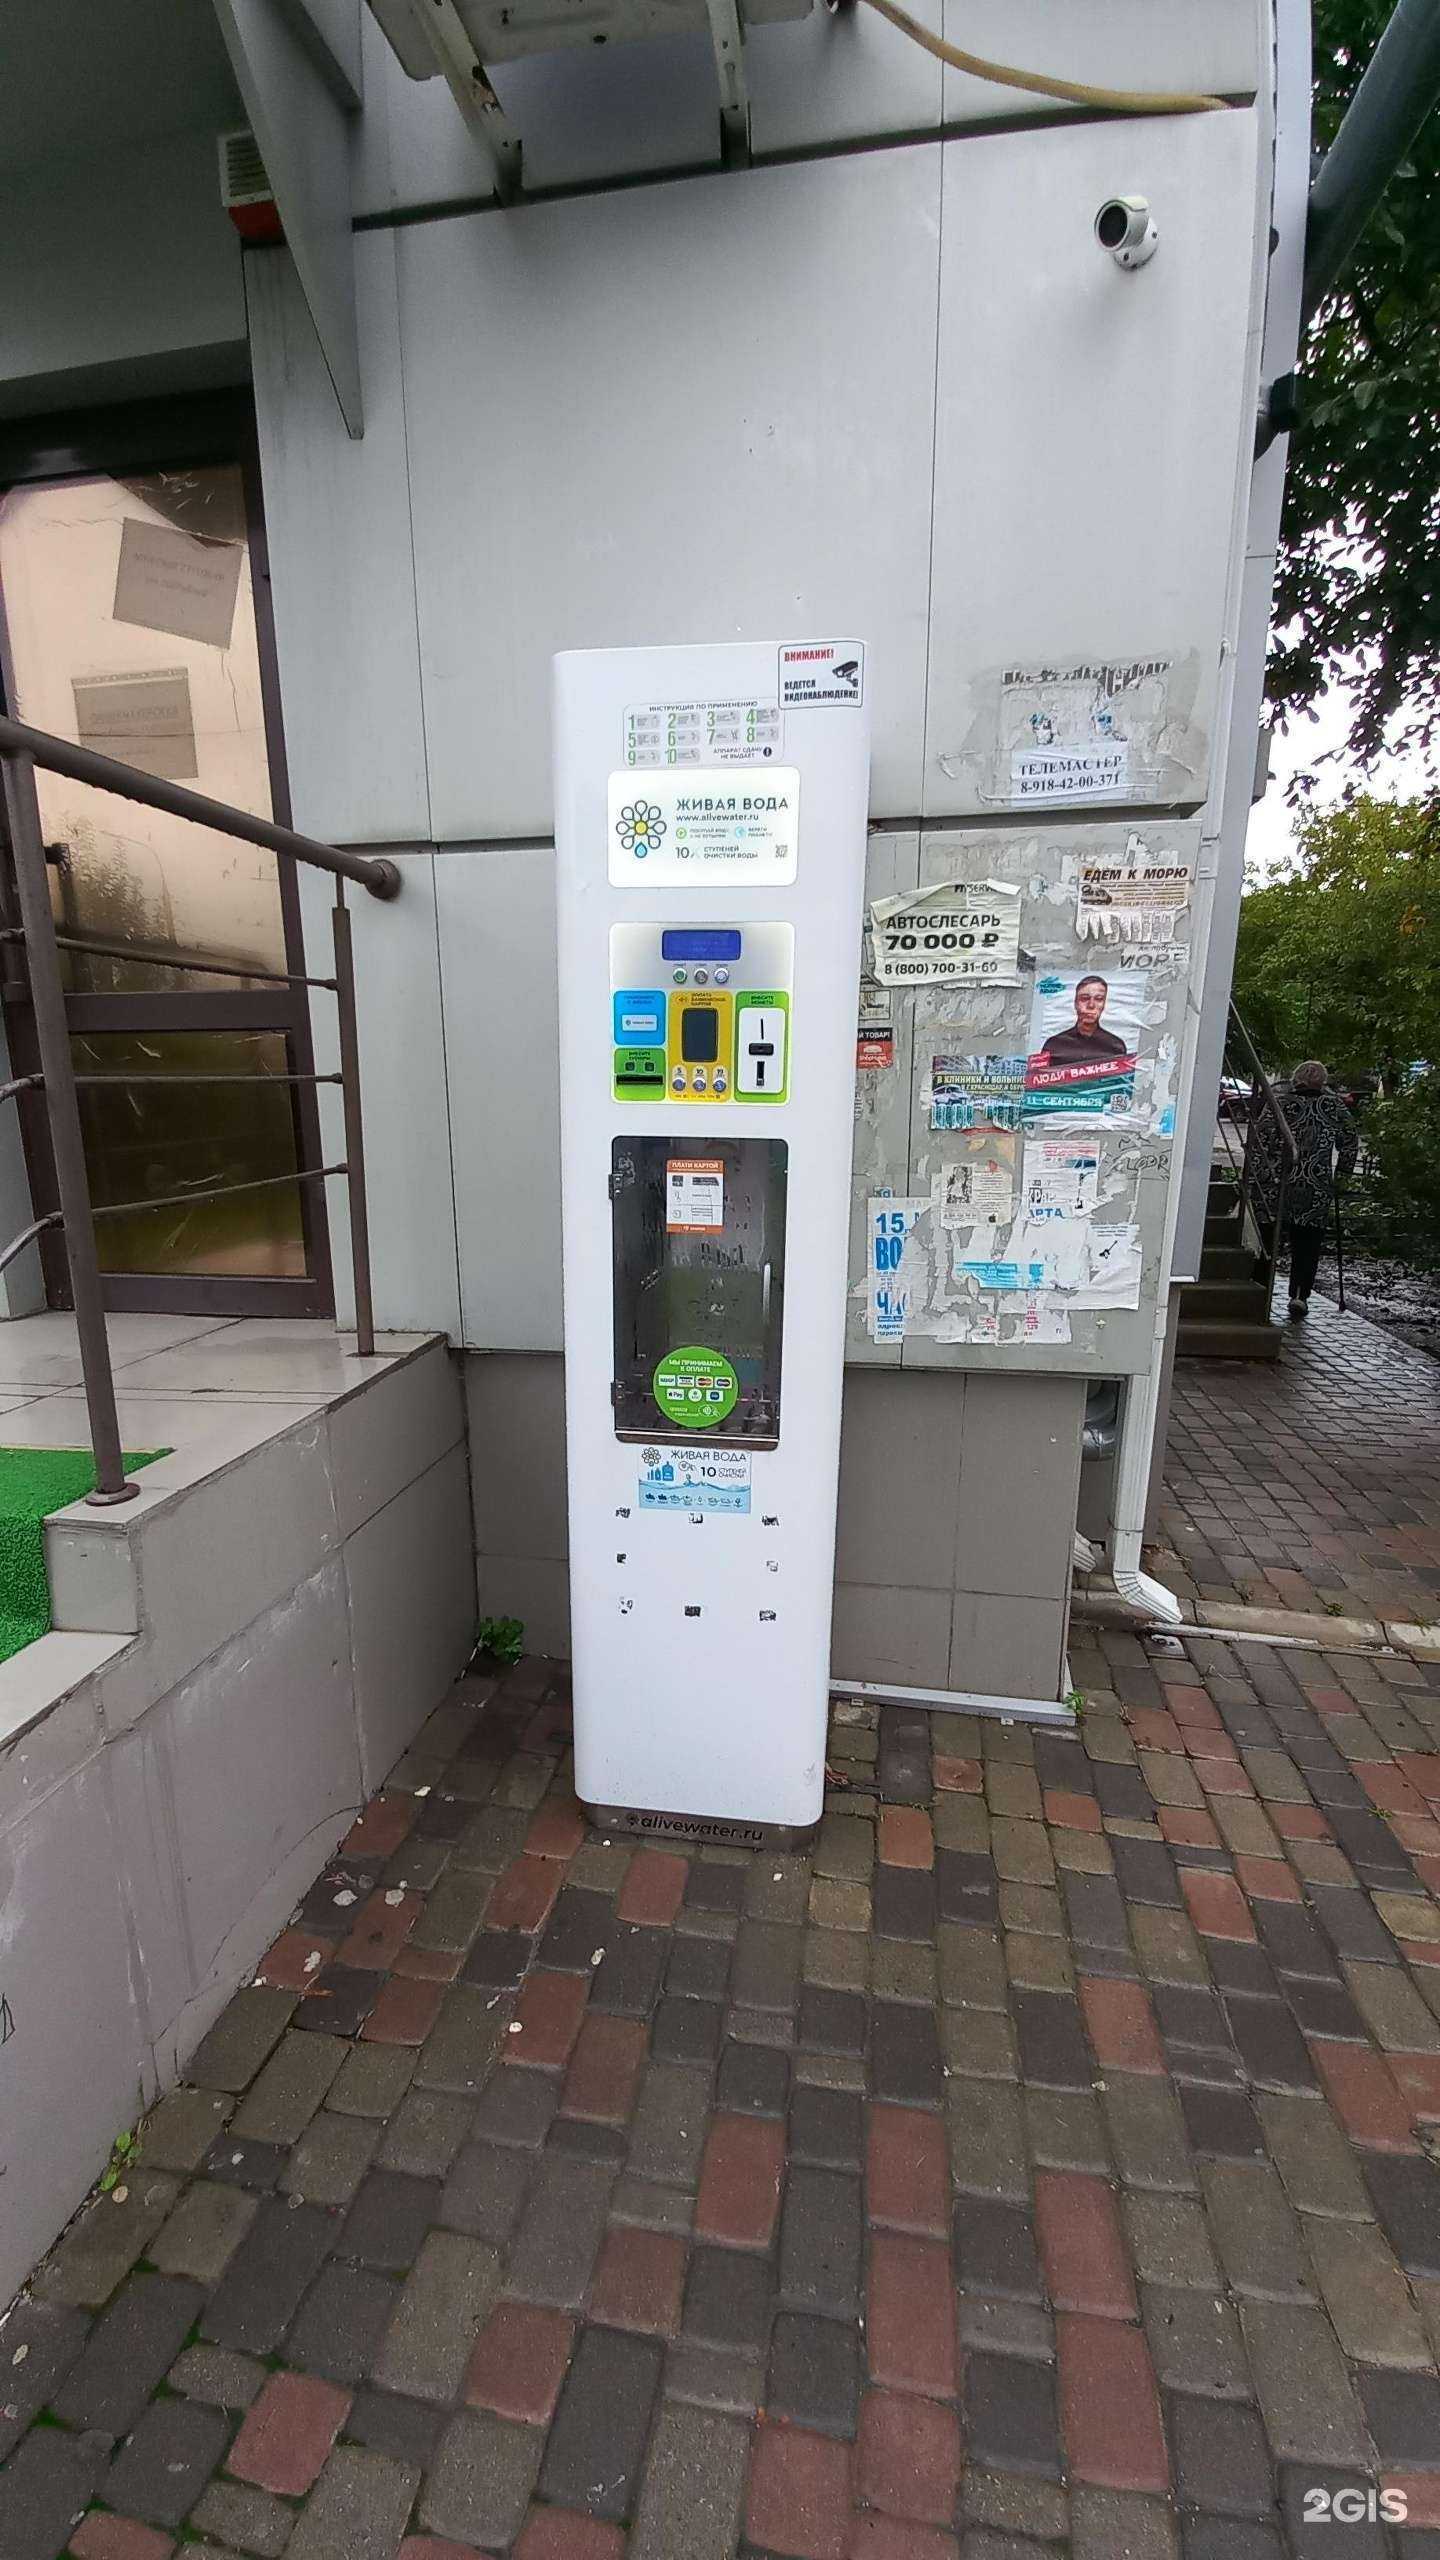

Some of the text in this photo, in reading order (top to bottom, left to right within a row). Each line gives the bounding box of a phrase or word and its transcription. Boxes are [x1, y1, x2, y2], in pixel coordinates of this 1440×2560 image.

[784, 648, 834, 662] ВНИМАНИЕ!
[784, 680, 816, 690] ВЕДЕТСЯ
[784, 690, 858, 702] ВИДЕОНАБЛЮДЕНИЕ!
[650, 704, 695, 712] ИНСТРУКЦИЯ
[708, 701, 758, 710] ПРИМЕНЕНИЮ
[628, 715, 636, 730] 1
[668, 713, 676, 728] 2
[706, 711, 716, 727] 3
[746, 709, 758, 724] 4
[628, 733, 636, 748] 5
[668, 731, 676, 746] 6
[706, 728, 716, 744] 7
[746, 727, 756, 743] 8
[628, 750, 636, 766] 9
[665, 749, 677, 764] 10
[1020, 773, 1119, 793] 8-918-42-00-371
[676, 797, 788, 811] ЖИВАЯ ВОДА
[676, 812, 759, 822] www.alivewater.ru
[675, 847, 690, 859] 10
[1083, 867, 1188, 882] ЕДЕМ К МОРЮ
[886, 914, 1000, 930] АВТОСЛЕСАРЬ
[886, 934, 916, 950] 70
[924, 934, 975, 949] 000
[885, 962, 998, 976] 8 (800) 700-31-60
[1033, 1061, 1119, 1084] ЛЮДИ ВАЖНЕЕ
[1042, 1096, 1103, 1106] СЕНТЯБРЯ
[671, 1450, 746, 1462] ЖИВАЯ ВОДА
[700, 1466, 716, 1477] 10
[640, 1814, 764, 1841] alivewater.ru
